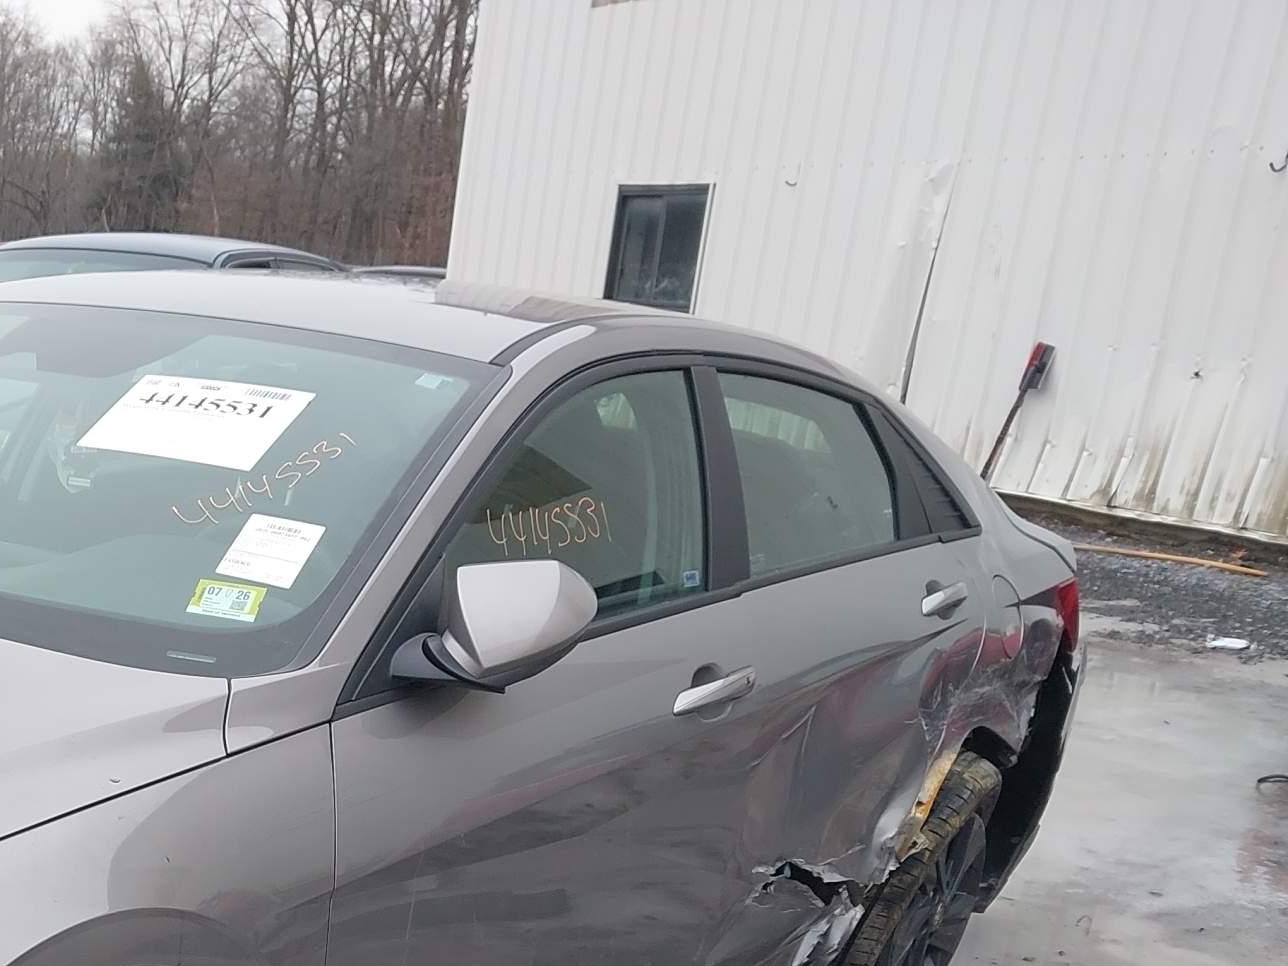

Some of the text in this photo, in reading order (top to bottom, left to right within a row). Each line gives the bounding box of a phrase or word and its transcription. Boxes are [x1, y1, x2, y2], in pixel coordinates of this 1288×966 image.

[139, 392, 274, 419] 44145531
[486, 496, 612, 557] 44145531
[207, 586, 252, 601] 07 26
